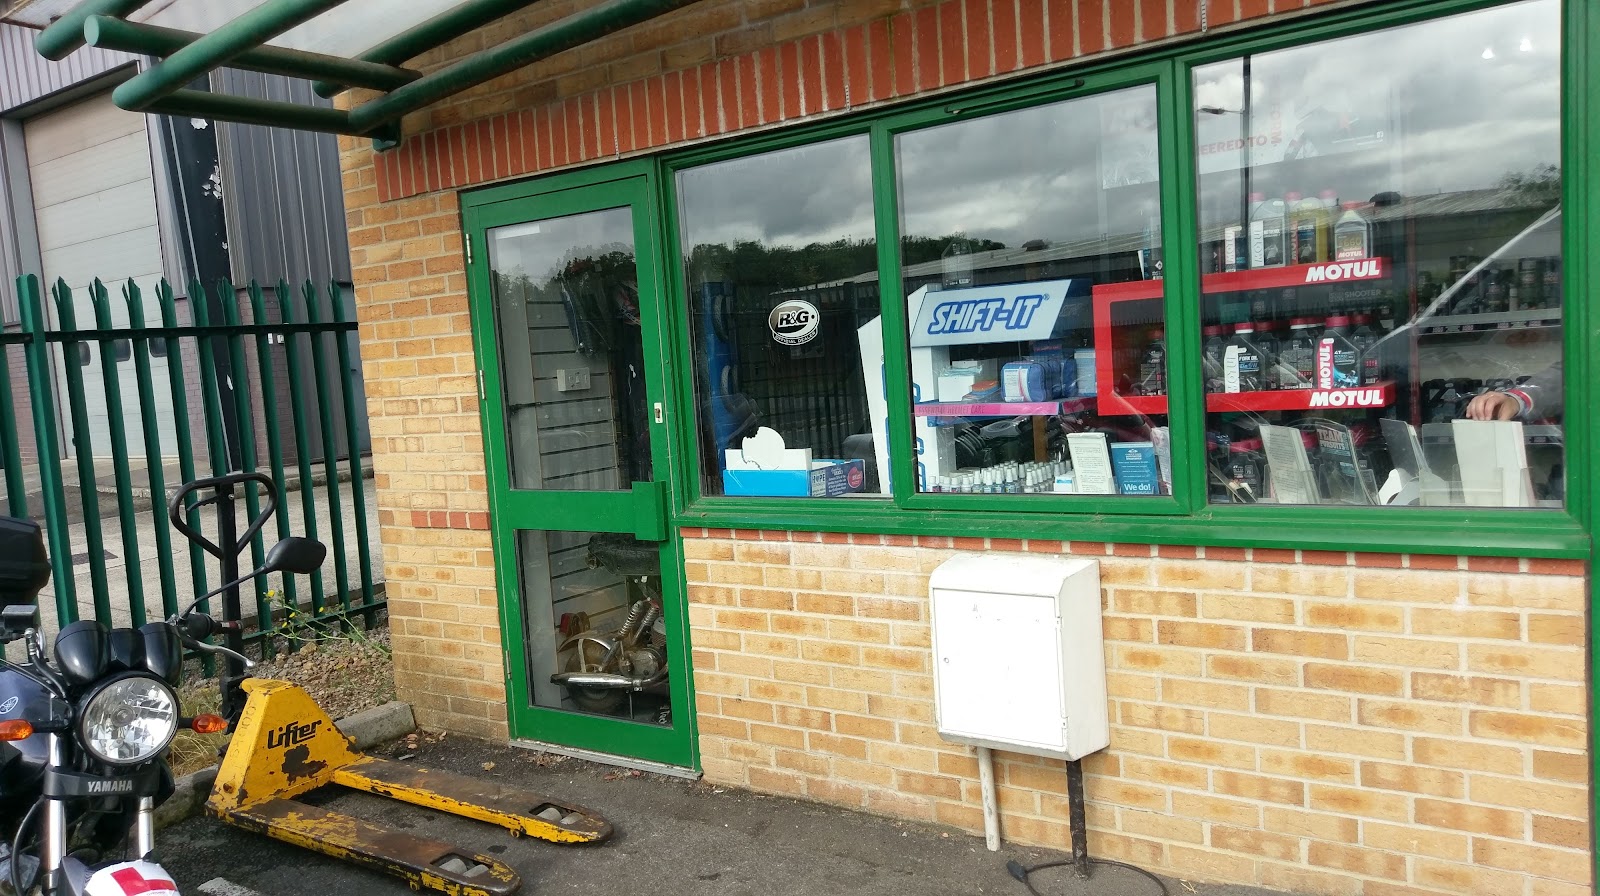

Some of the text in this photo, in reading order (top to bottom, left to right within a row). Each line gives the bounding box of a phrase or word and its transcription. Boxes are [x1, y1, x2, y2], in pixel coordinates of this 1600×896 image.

[1198, 134, 1267, 156] EERED TO
[1338, 250, 1363, 259] MOTUL
[1305, 260, 1380, 283] MOTUL
[1344, 288, 1382, 299] SHOOTER
[778, 310, 810, 327] R&G
[1320, 347, 1331, 389] MOTUL
[1309, 389, 1384, 407] MOTUL
[1316, 428, 1343, 442] TEAM
[1123, 483, 1151, 491] We do!
[266, 719, 323, 750] Lifter
[87, 780, 133, 793] YAMAHA
